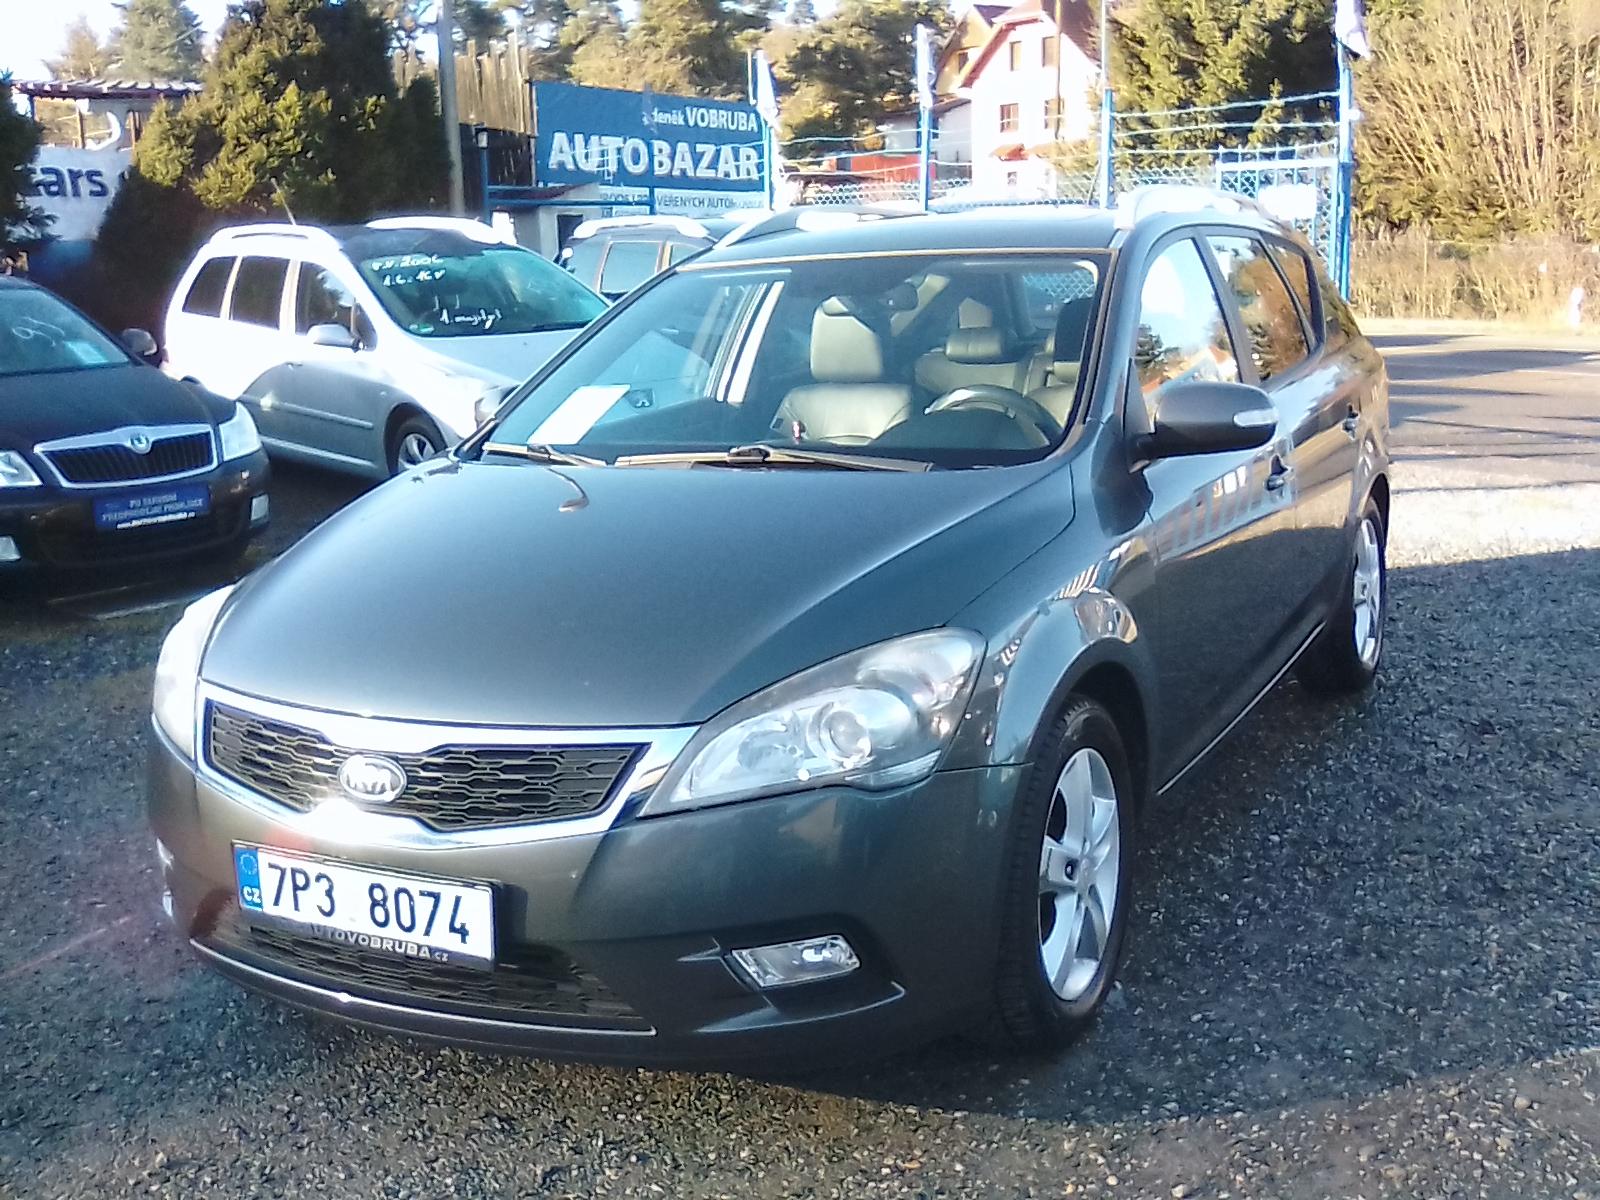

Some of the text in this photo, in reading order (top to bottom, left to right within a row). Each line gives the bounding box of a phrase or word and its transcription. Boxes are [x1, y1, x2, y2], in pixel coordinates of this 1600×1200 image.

[685, 105, 758, 132] VOBRUBA
[242, 885, 262, 904] CZ
[268, 862, 470, 945] 7P3 8074
